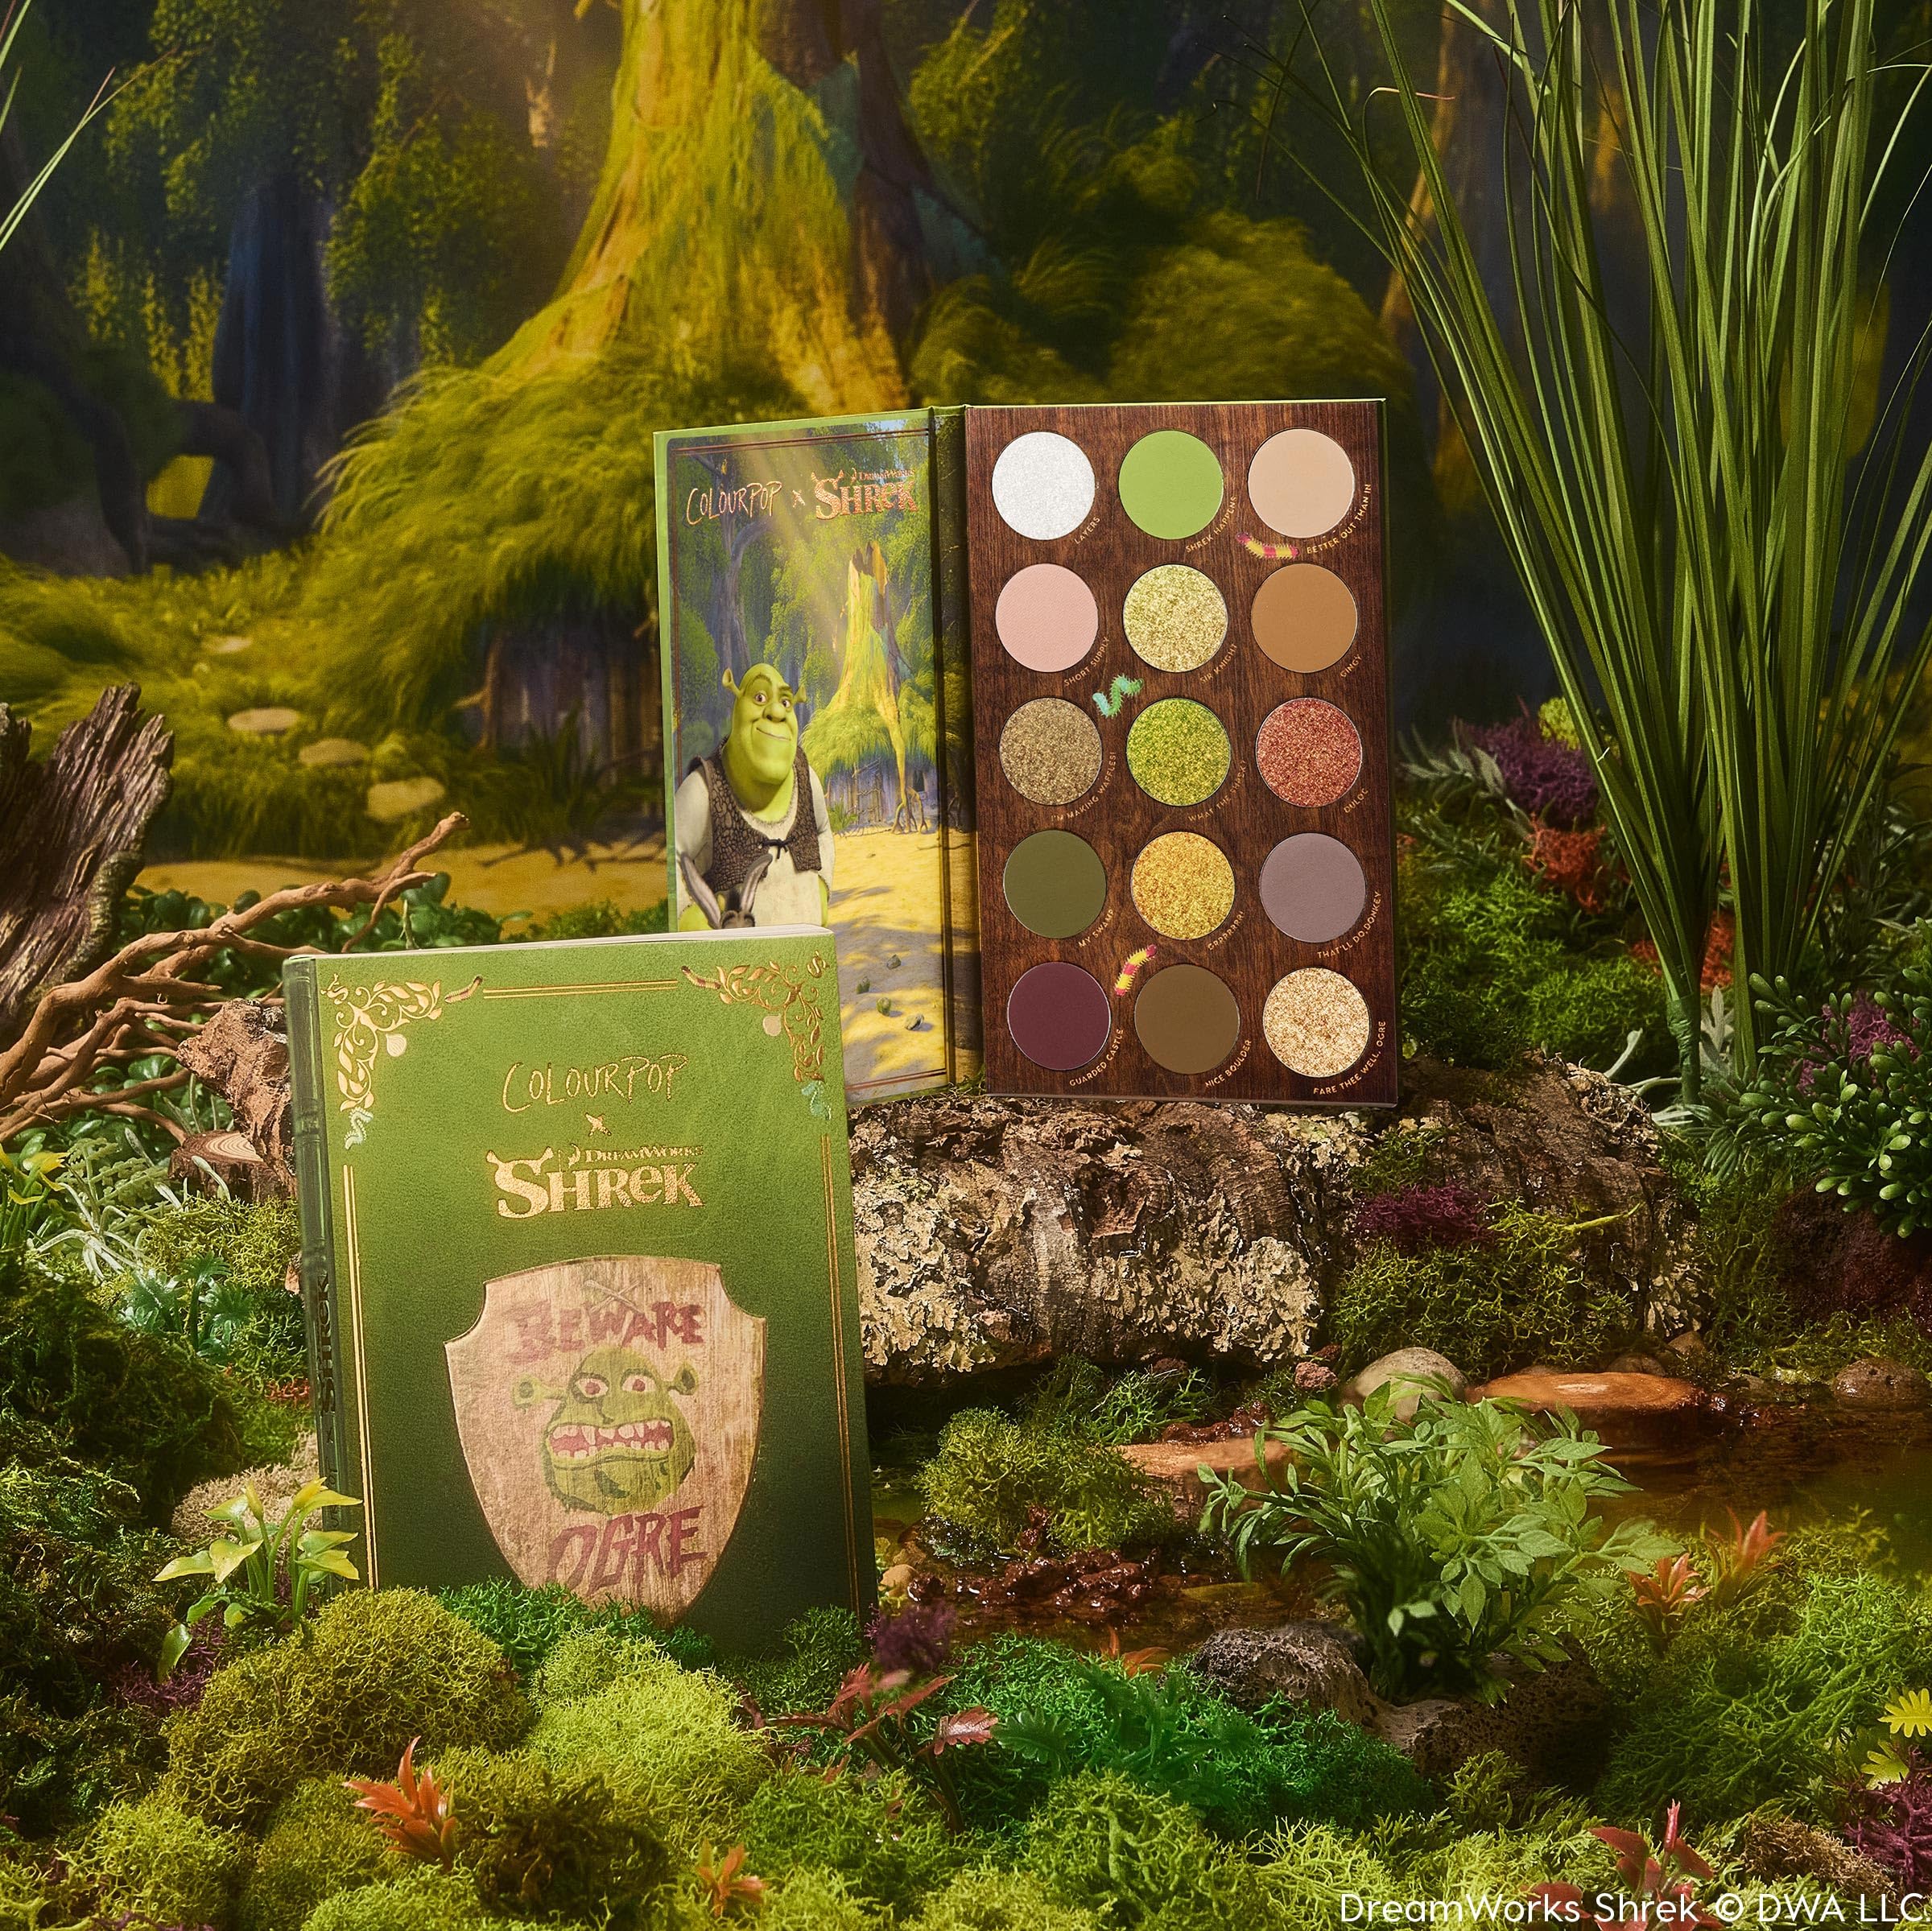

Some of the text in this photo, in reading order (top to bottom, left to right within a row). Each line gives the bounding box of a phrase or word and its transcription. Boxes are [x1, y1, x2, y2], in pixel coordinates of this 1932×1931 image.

[686, 480, 782, 526] COLOURPOP
[1186, 496, 1237, 553] SHREK HAPPENS
[1307, 484, 1372, 554] BETTER OUT THAN IN
[1074, 516, 1100, 545] LAYERS
[1063, 636, 1110, 687] SHORT SUPPLY
[1199, 643, 1237, 684] SIR KNIGHT
[1340, 654, 1362, 678] GINGY
[1067, 795, 1099, 819] MAKING
[1097, 752, 1117, 794] WAFFLES!
[1187, 808, 1214, 821] WHAT
[1216, 794, 1232, 809] THE
[1344, 788, 1368, 813] DULOC
[1078, 909, 1113, 947] MY SWAMP
[1317, 942, 1352, 959] THAT'LL
[1364, 891, 1381, 930] DONKEY
[502, 1054, 689, 1112] COLOURPOP
[1069, 1029, 1124, 1087] GUARDED CASTLE
[1204, 1039, 1252, 1088] NICE BOULDER
[1313, 1085, 1338, 1095] FARE
[1339, 1073, 1362, 1090] THEE
[1376, 1021, 1386, 1046] OGRE
[502, 1300, 707, 1365] BEWARE
[546, 1505, 709, 1597] OGRE
